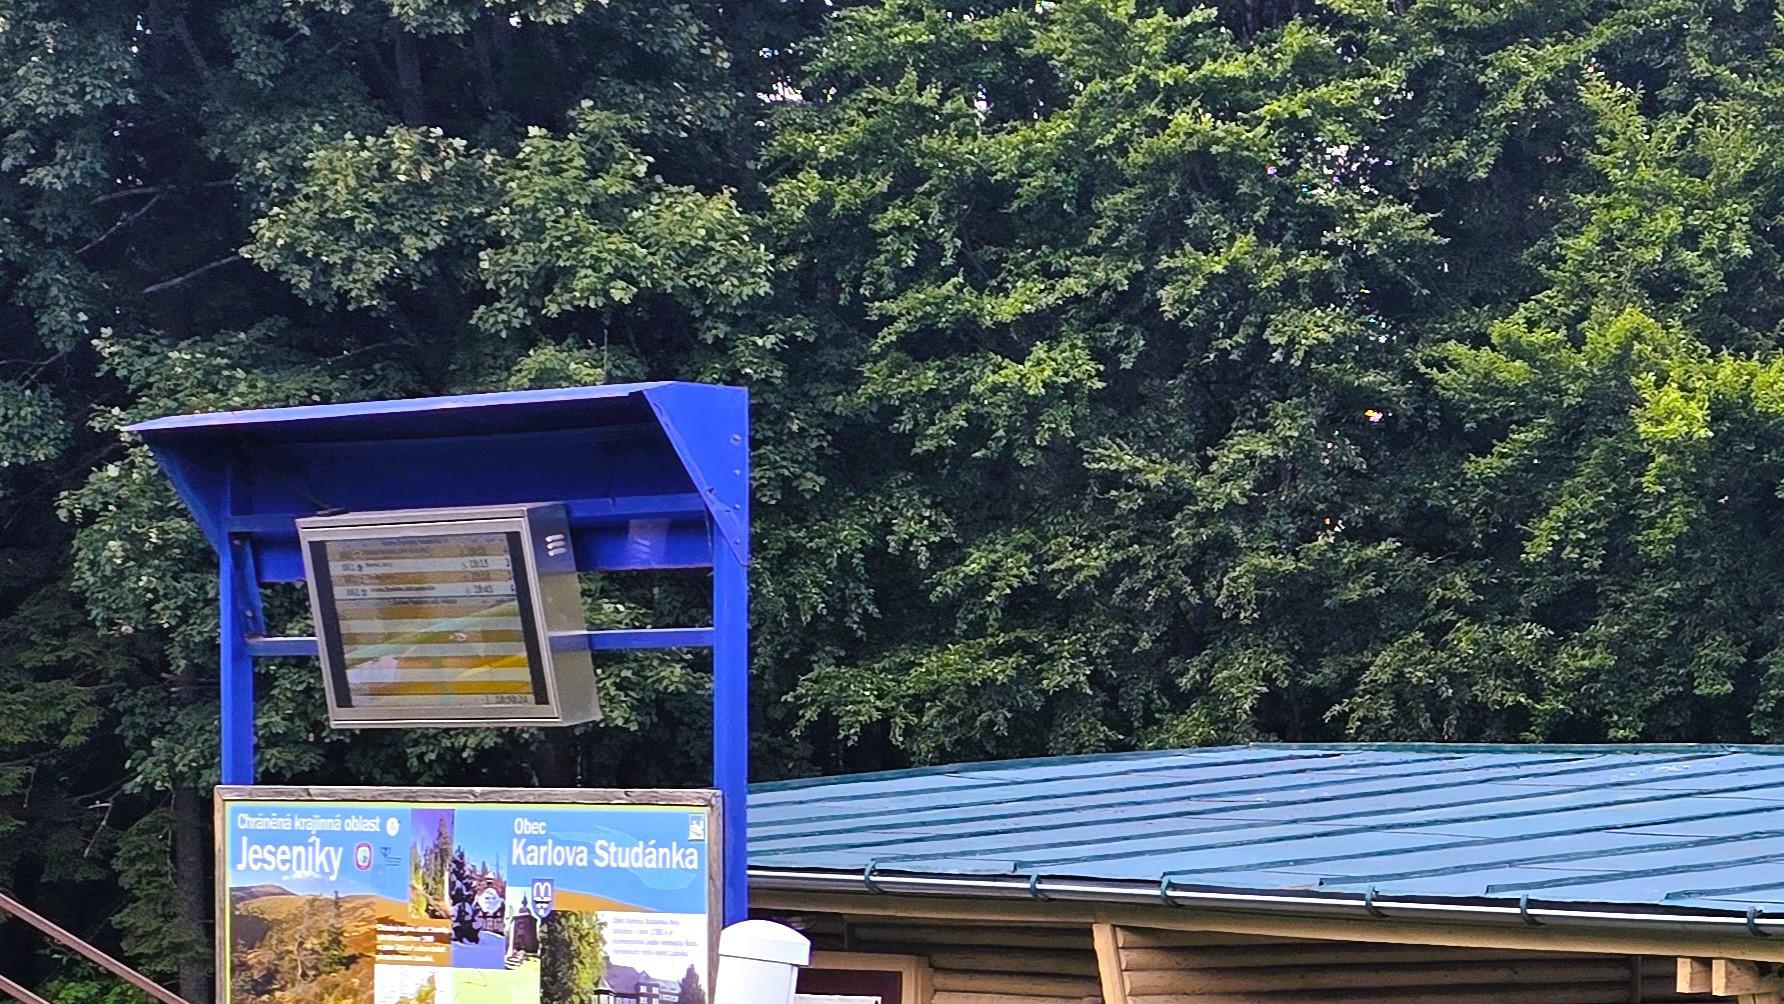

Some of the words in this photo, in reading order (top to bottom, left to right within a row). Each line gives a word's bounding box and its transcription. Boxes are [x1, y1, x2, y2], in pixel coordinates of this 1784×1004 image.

[344, 815, 381, 832] oblast
[514, 817, 547, 835] Obec
[236, 835, 343, 881] Jeseníky
[512, 838, 588, 867] Karlova
[593, 839, 699, 869] Studánka
